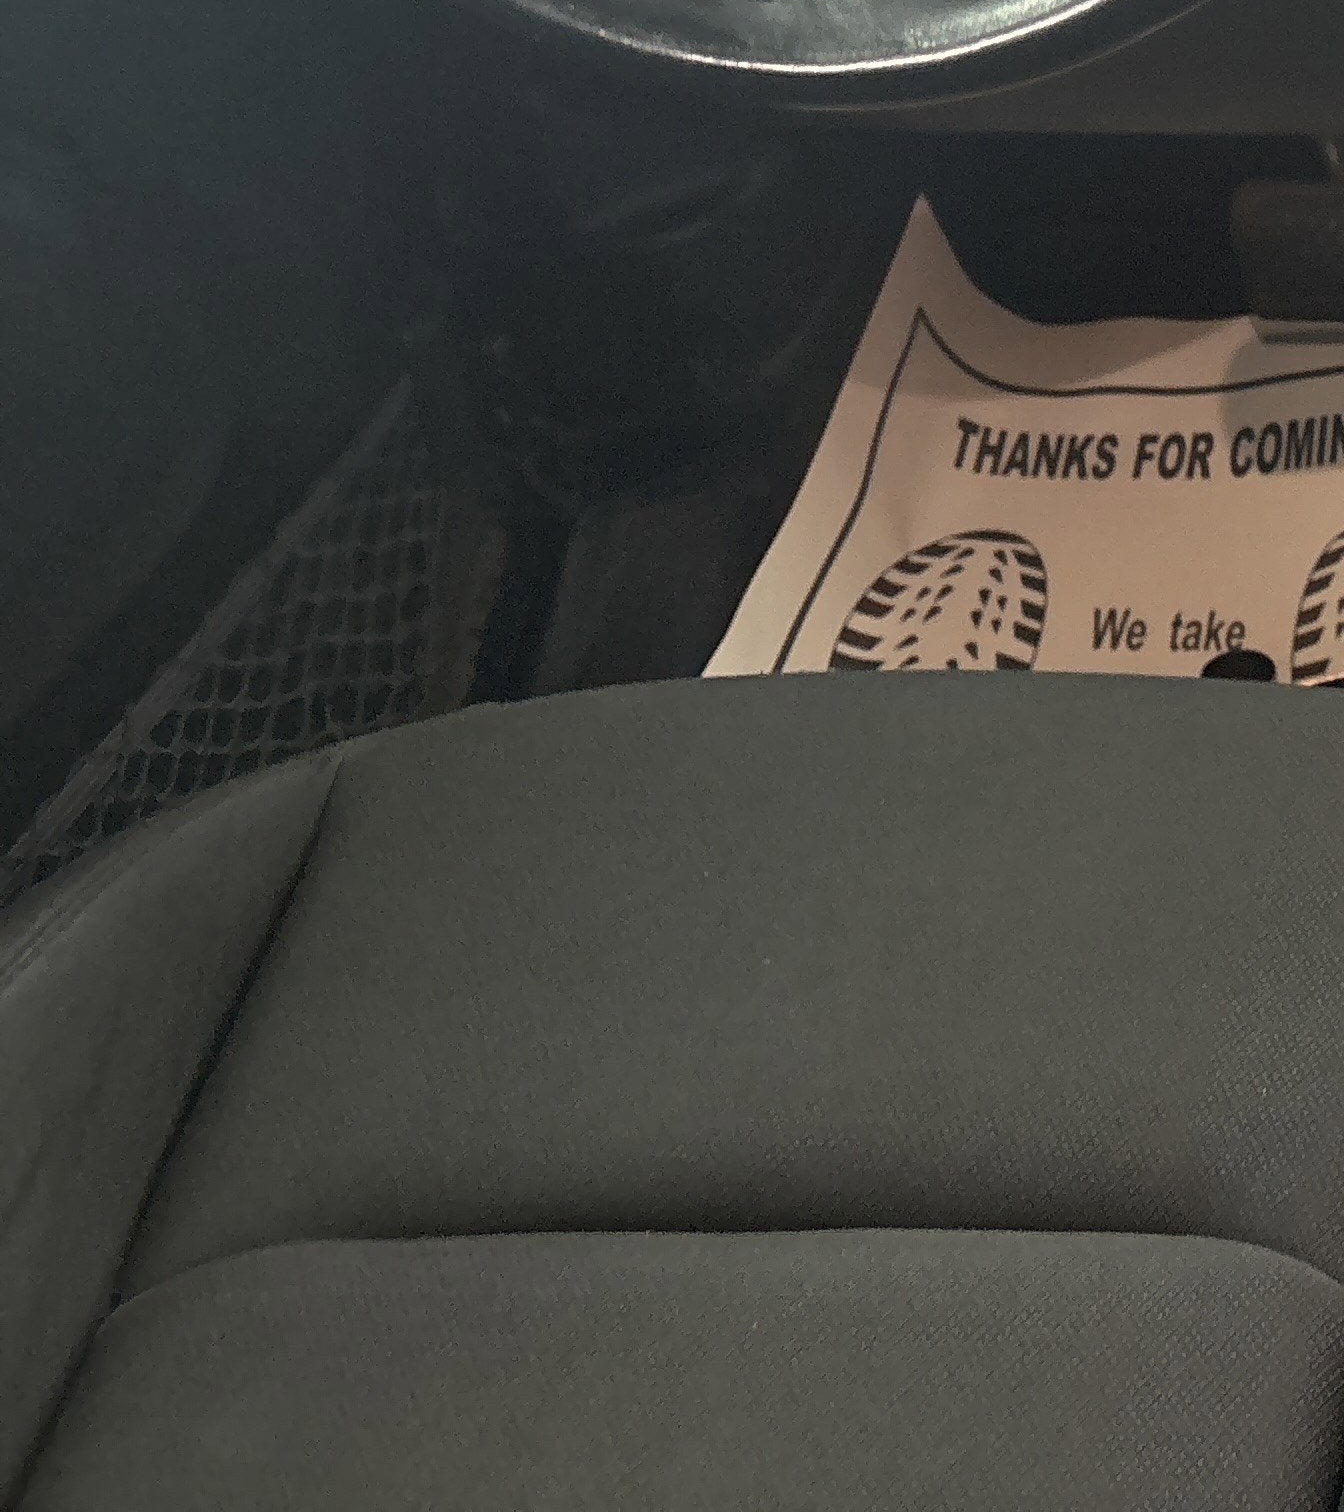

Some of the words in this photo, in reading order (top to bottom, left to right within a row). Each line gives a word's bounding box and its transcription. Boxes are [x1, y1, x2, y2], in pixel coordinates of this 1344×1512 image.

[952, 417, 1120, 481] THANKS
[1132, 431, 1215, 481] FOR
[1091, 607, 1147, 651] We
[1168, 607, 1247, 653] take
